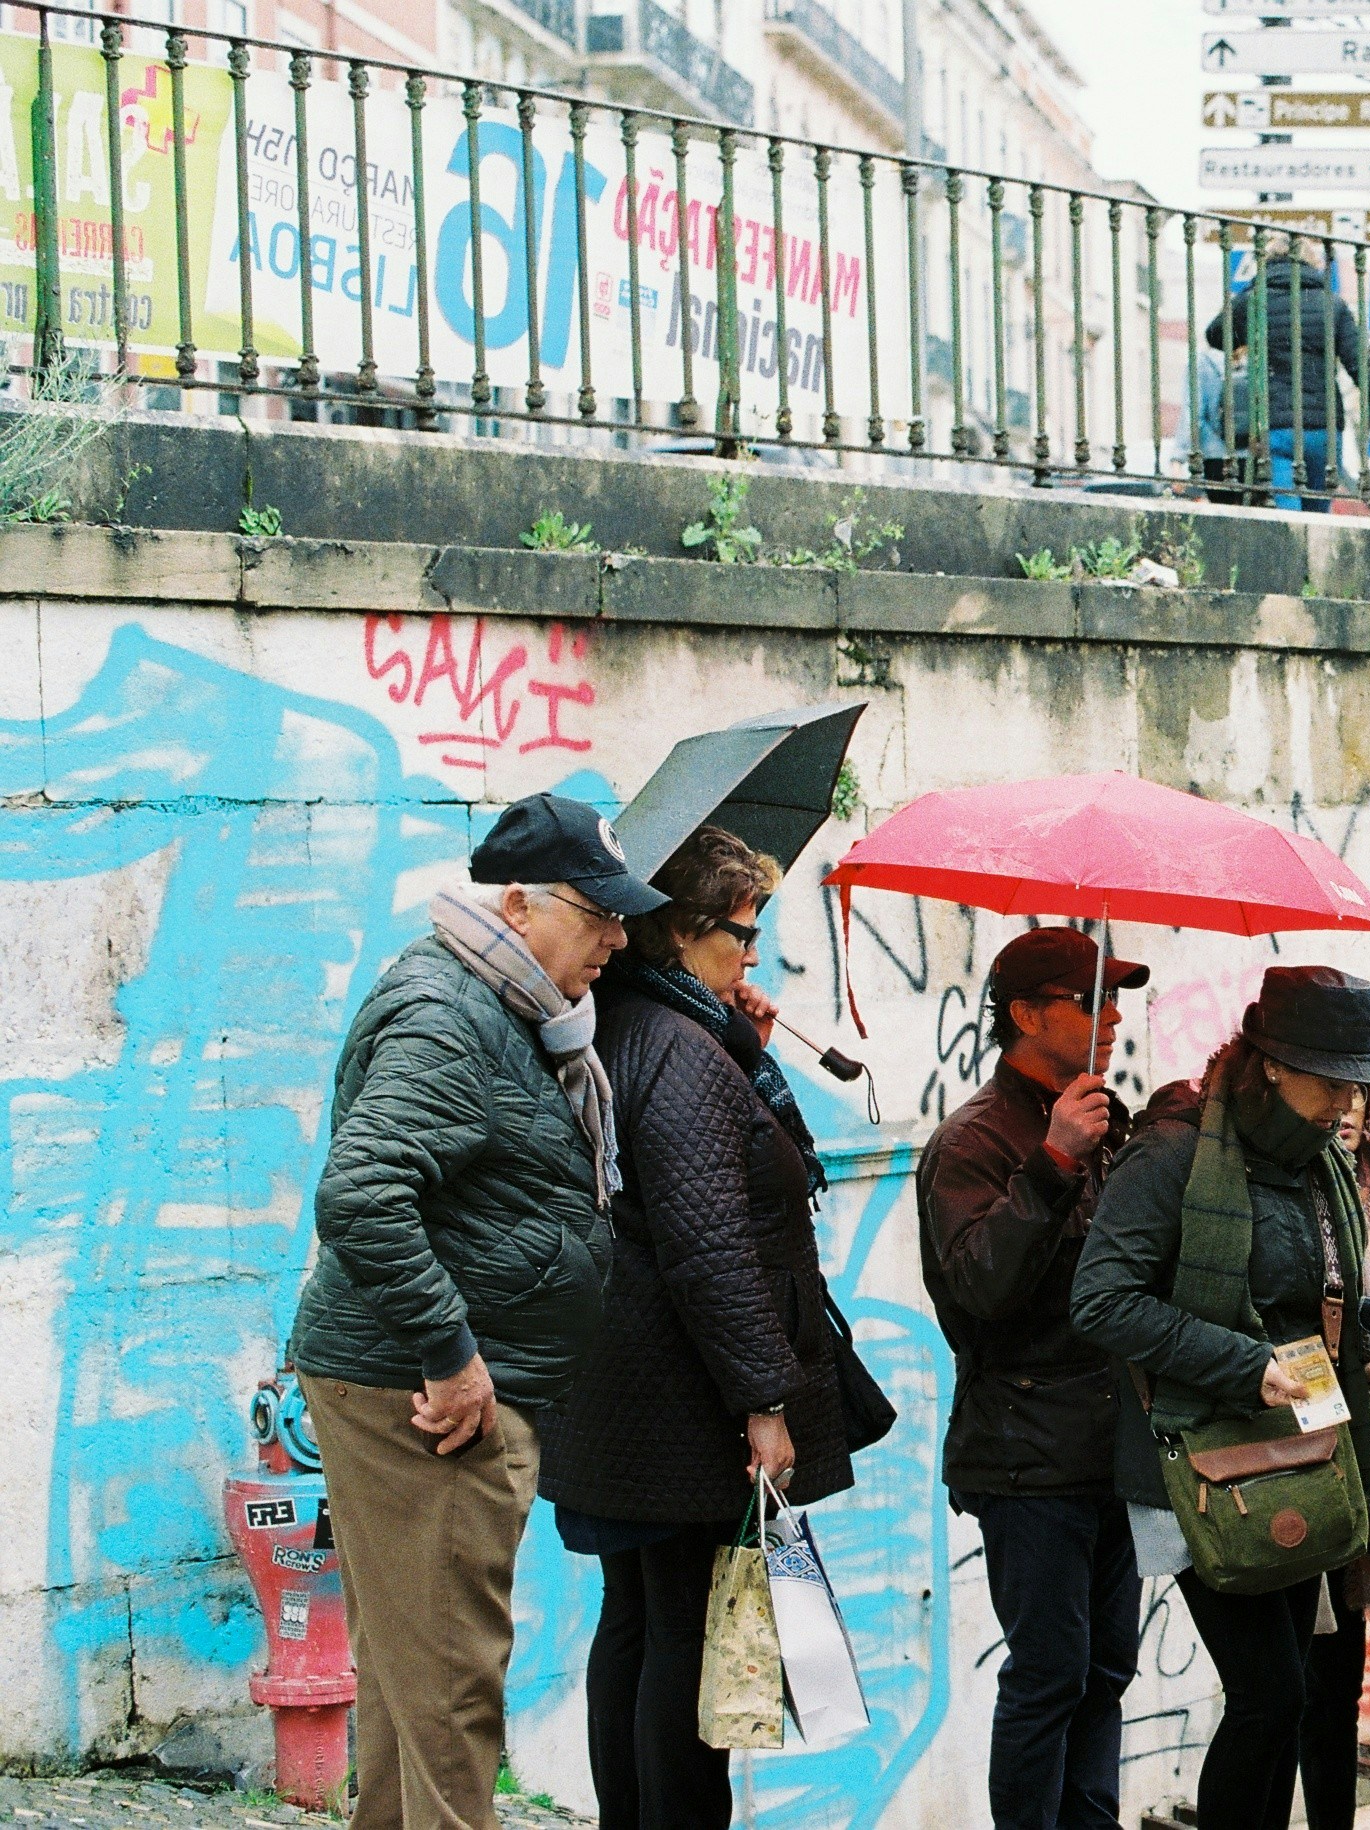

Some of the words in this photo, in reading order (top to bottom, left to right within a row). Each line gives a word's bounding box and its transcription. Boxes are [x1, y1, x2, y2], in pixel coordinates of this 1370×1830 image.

[1204, 158, 1357, 178] Restauradores
[274, 1546, 324, 1572] RON'S
[285, 1560, 310, 1571] crew
